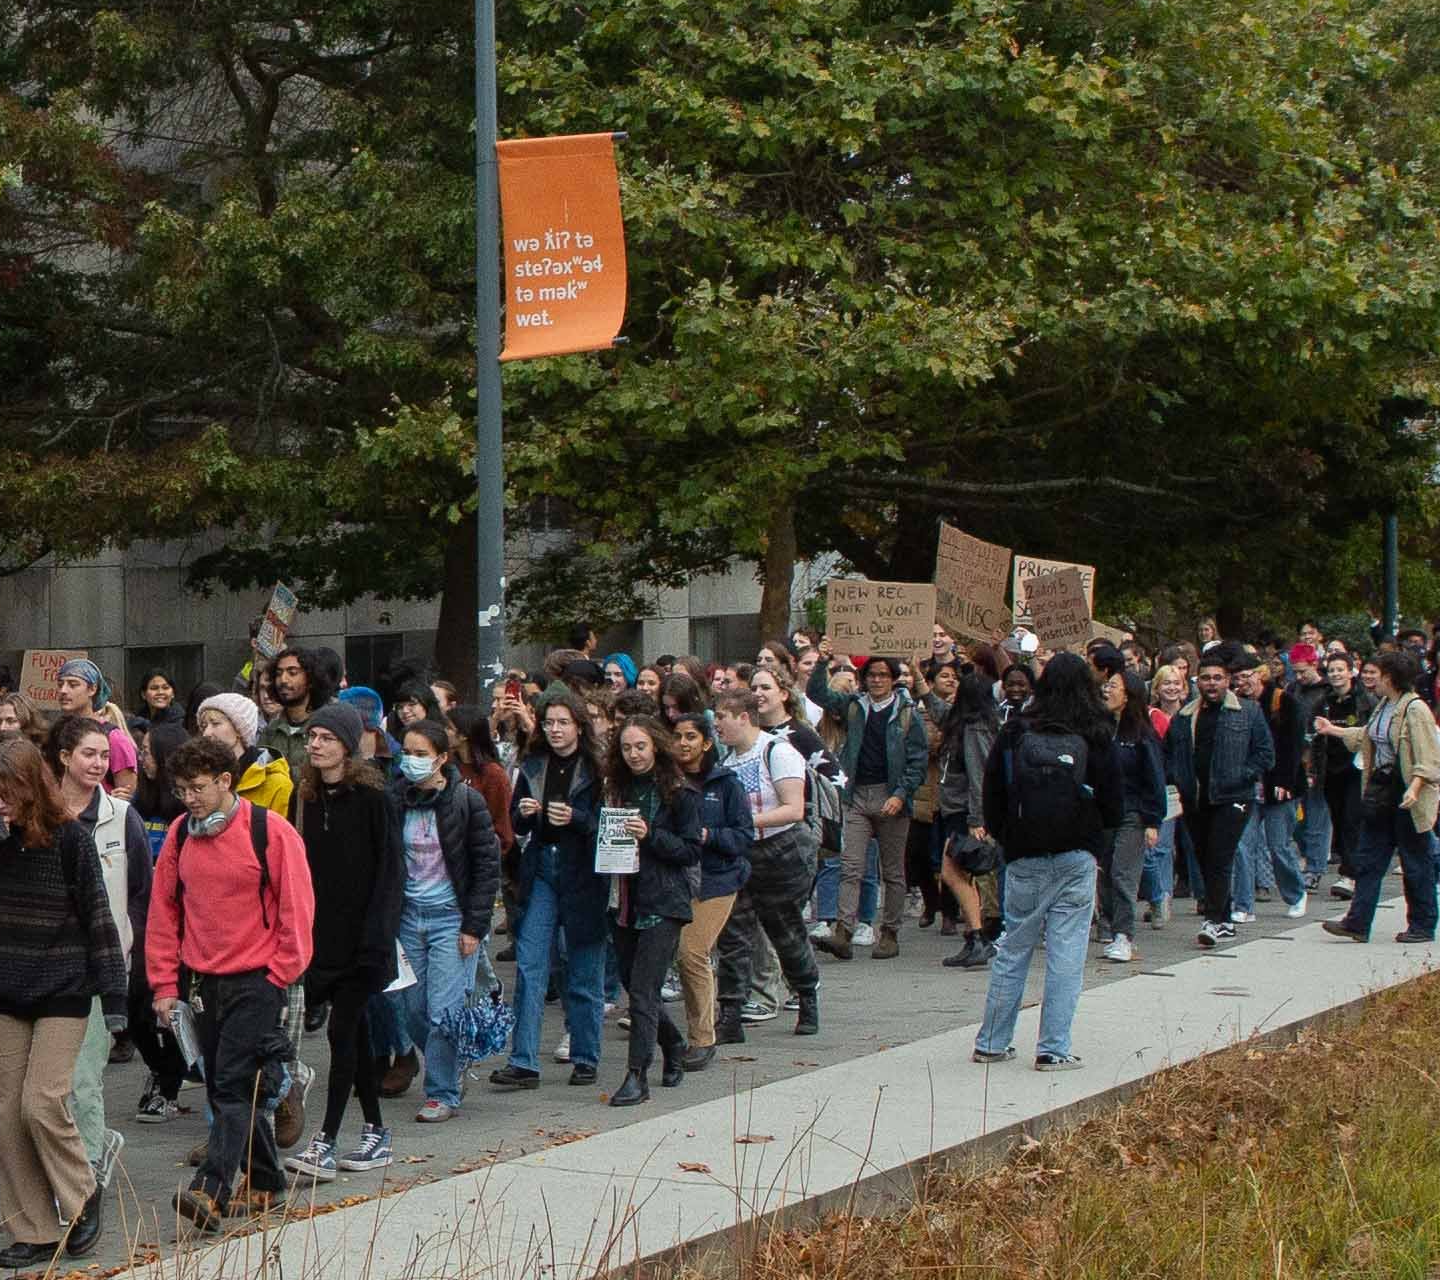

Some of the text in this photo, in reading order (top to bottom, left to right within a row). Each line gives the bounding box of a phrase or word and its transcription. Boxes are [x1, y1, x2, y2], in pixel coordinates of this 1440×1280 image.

[834, 586, 906, 601] NEW REC
[834, 621, 895, 637] FILL OUR
